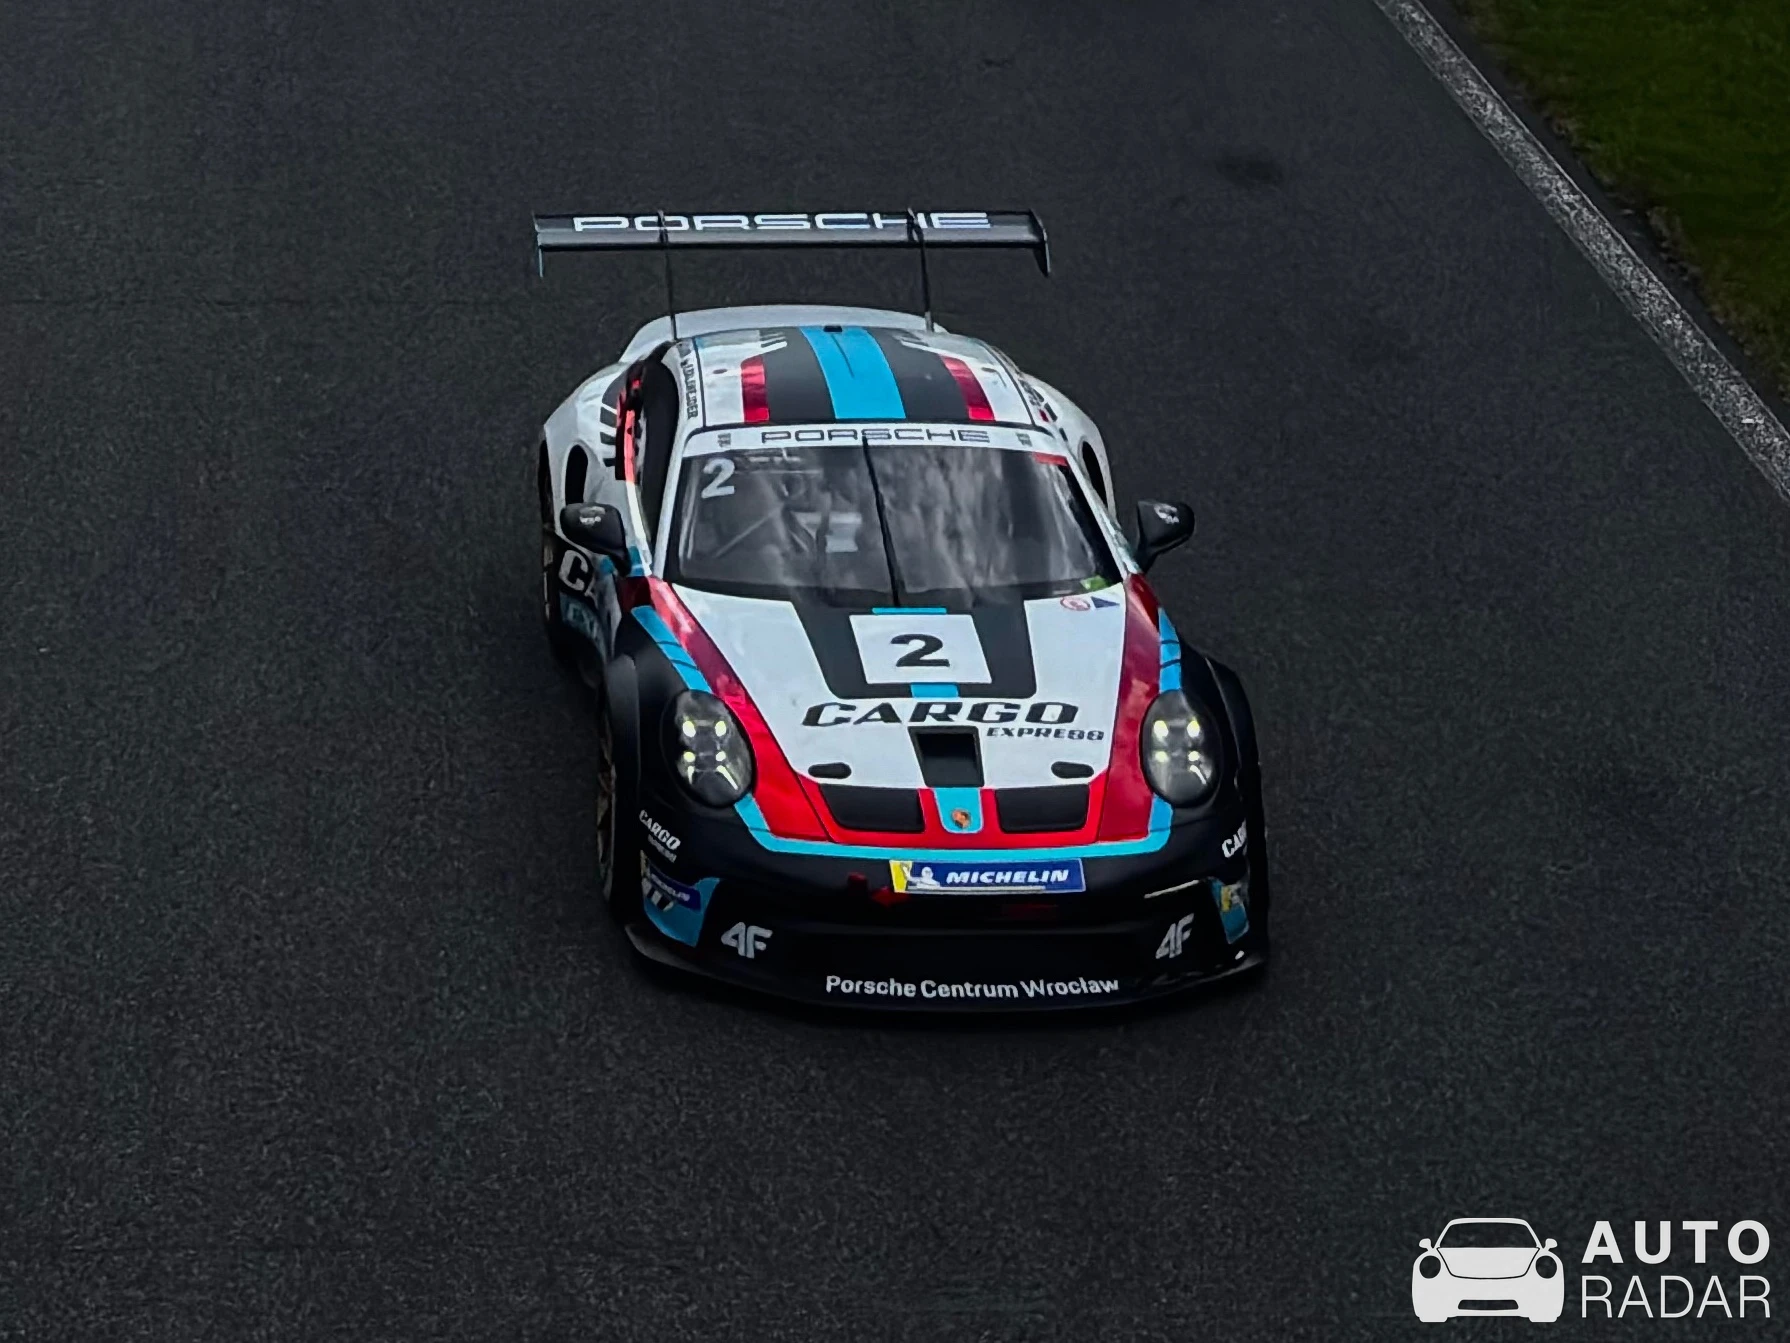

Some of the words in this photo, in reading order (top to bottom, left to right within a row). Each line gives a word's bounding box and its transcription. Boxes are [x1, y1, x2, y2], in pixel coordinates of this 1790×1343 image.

[573, 212, 991, 232] PORSCHE
[761, 428, 991, 443] PORSCHE
[701, 457, 736, 499] 2
[889, 634, 951, 668] 2
[801, 701, 1079, 727] CARGO
[986, 727, 1105, 741] EXPRESS
[639, 809, 682, 851] CARGO
[946, 869, 1070, 884] MICHELIN
[720, 921, 773, 959] 4F
[1155, 912, 1195, 960] 4F
[825, 975, 917, 997] Porsche
[920, 979, 1019, 998] Centrum
